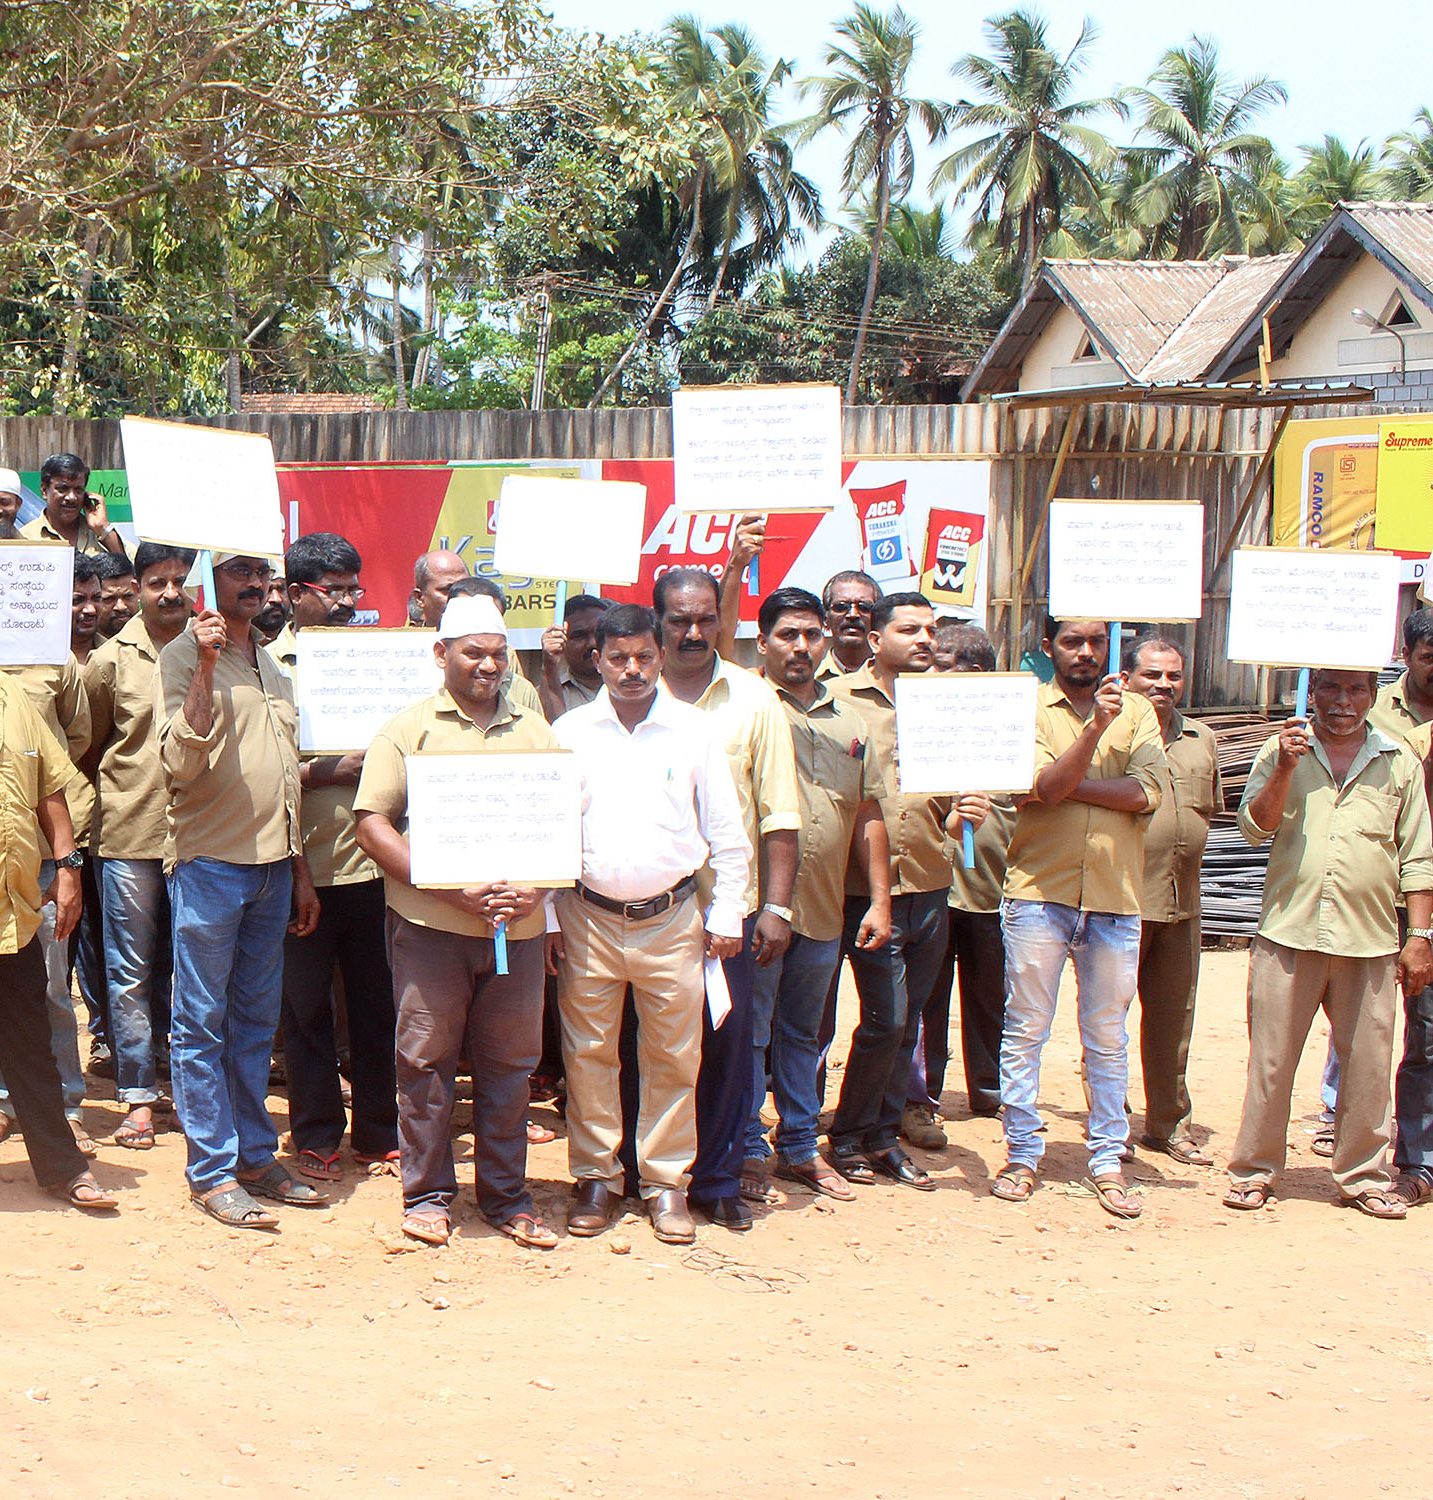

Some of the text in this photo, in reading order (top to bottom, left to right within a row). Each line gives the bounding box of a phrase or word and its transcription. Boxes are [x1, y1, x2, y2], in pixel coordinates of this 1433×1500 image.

[1385, 432, 1433, 450] Supreme
[98, 482, 128, 498] Mar
[865, 500, 897, 519] ACC
[1310, 471, 1324, 536] RAMCO
[939, 525, 972, 541] ACC
[19, 562, 55, 572] ಉಡುಪಿ
[10, 582, 45, 597] ಸಂಸ್ಥೆಯ
[535, 581, 555, 589] STE
[10, 601, 58, 614] ಅನ್ಯಾಯದ
[504, 594, 557, 610] BARS
[1, 620, 45, 629] ಹೋರಾಟ
